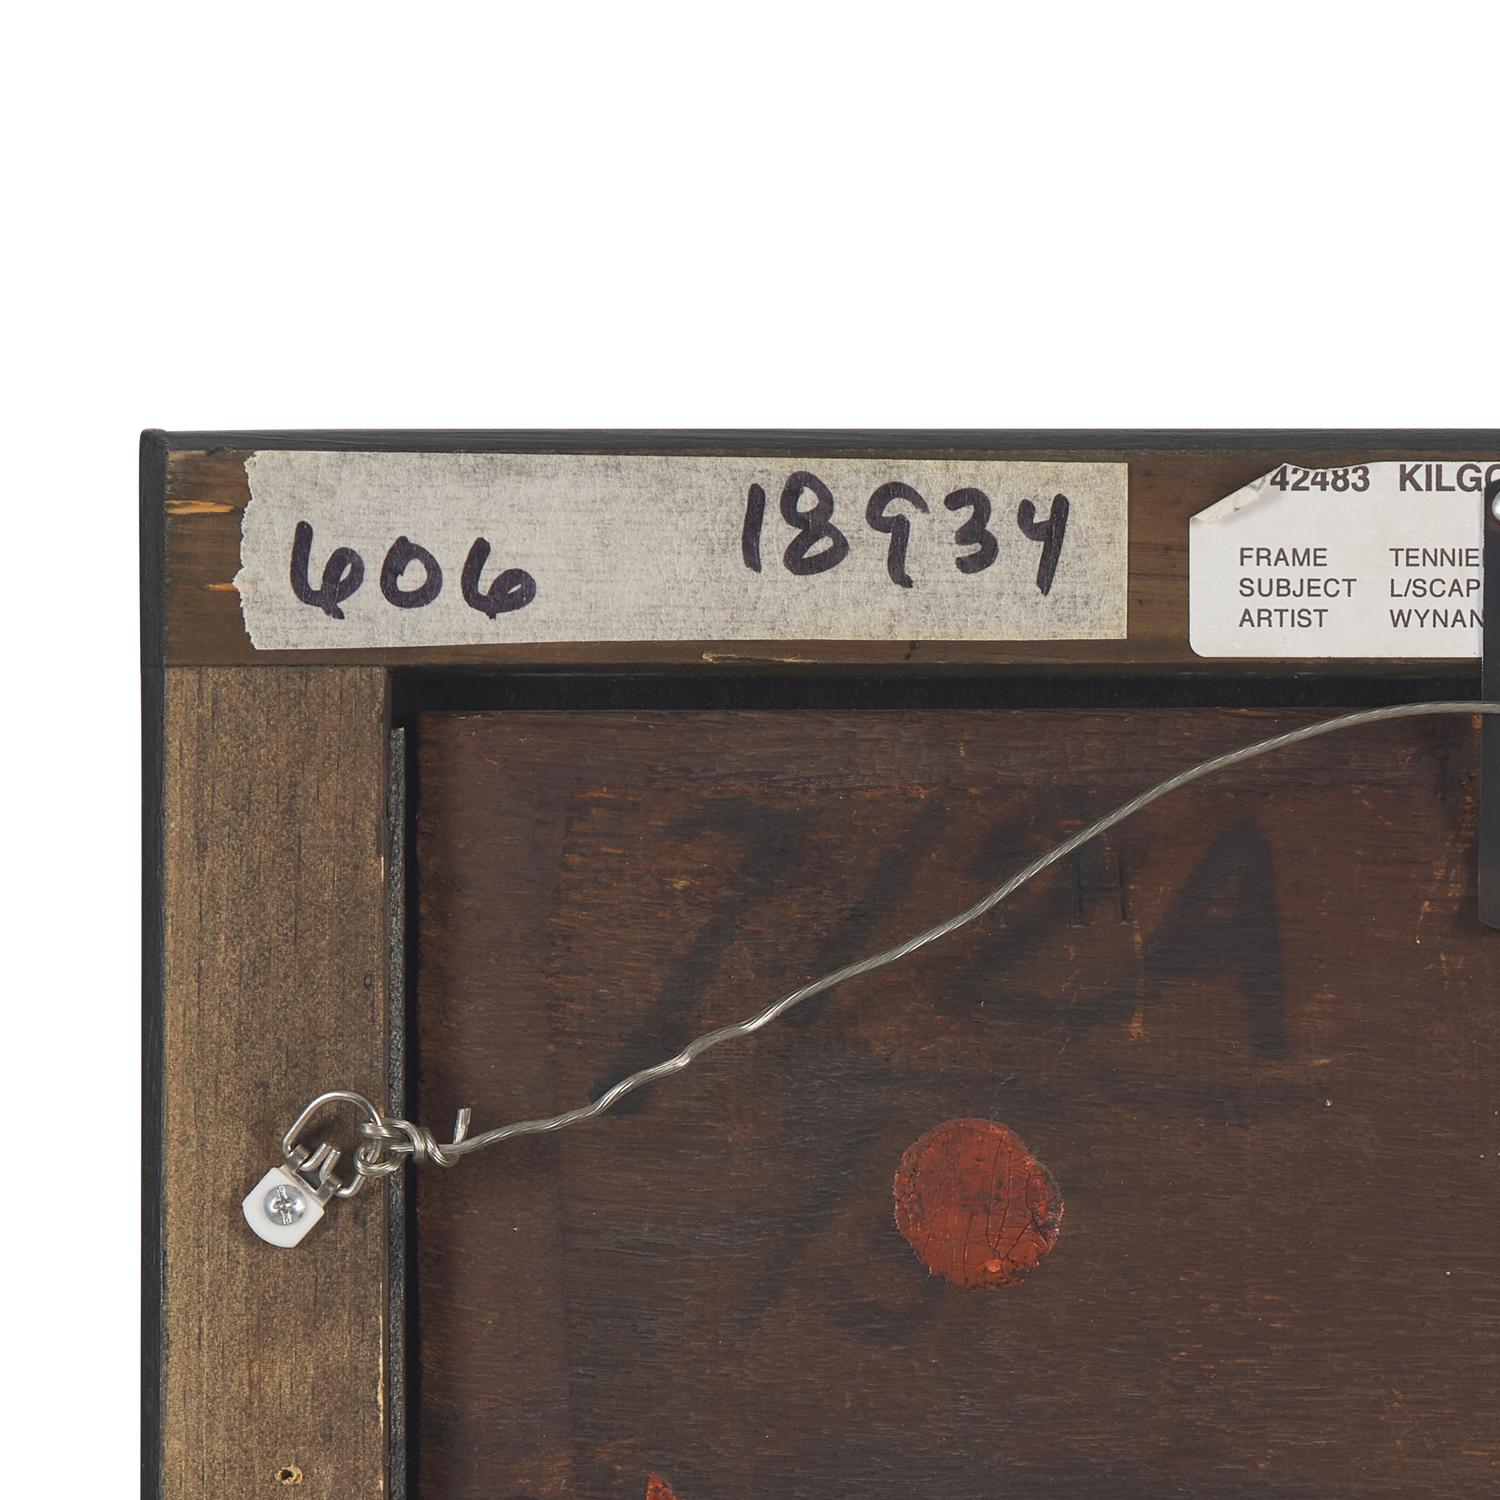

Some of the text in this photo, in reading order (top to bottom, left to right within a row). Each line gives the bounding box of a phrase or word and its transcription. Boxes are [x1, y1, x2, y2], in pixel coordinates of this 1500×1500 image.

[1269, 464, 1370, 492] 42483
[1240, 548, 1479, 566] FRAME TENNIE
[290, 521, 536, 619] 606
[1240, 578, 1480, 597] SUBJECT L/SCAP
[1239, 609, 1480, 627] ARTIST WYNAN
